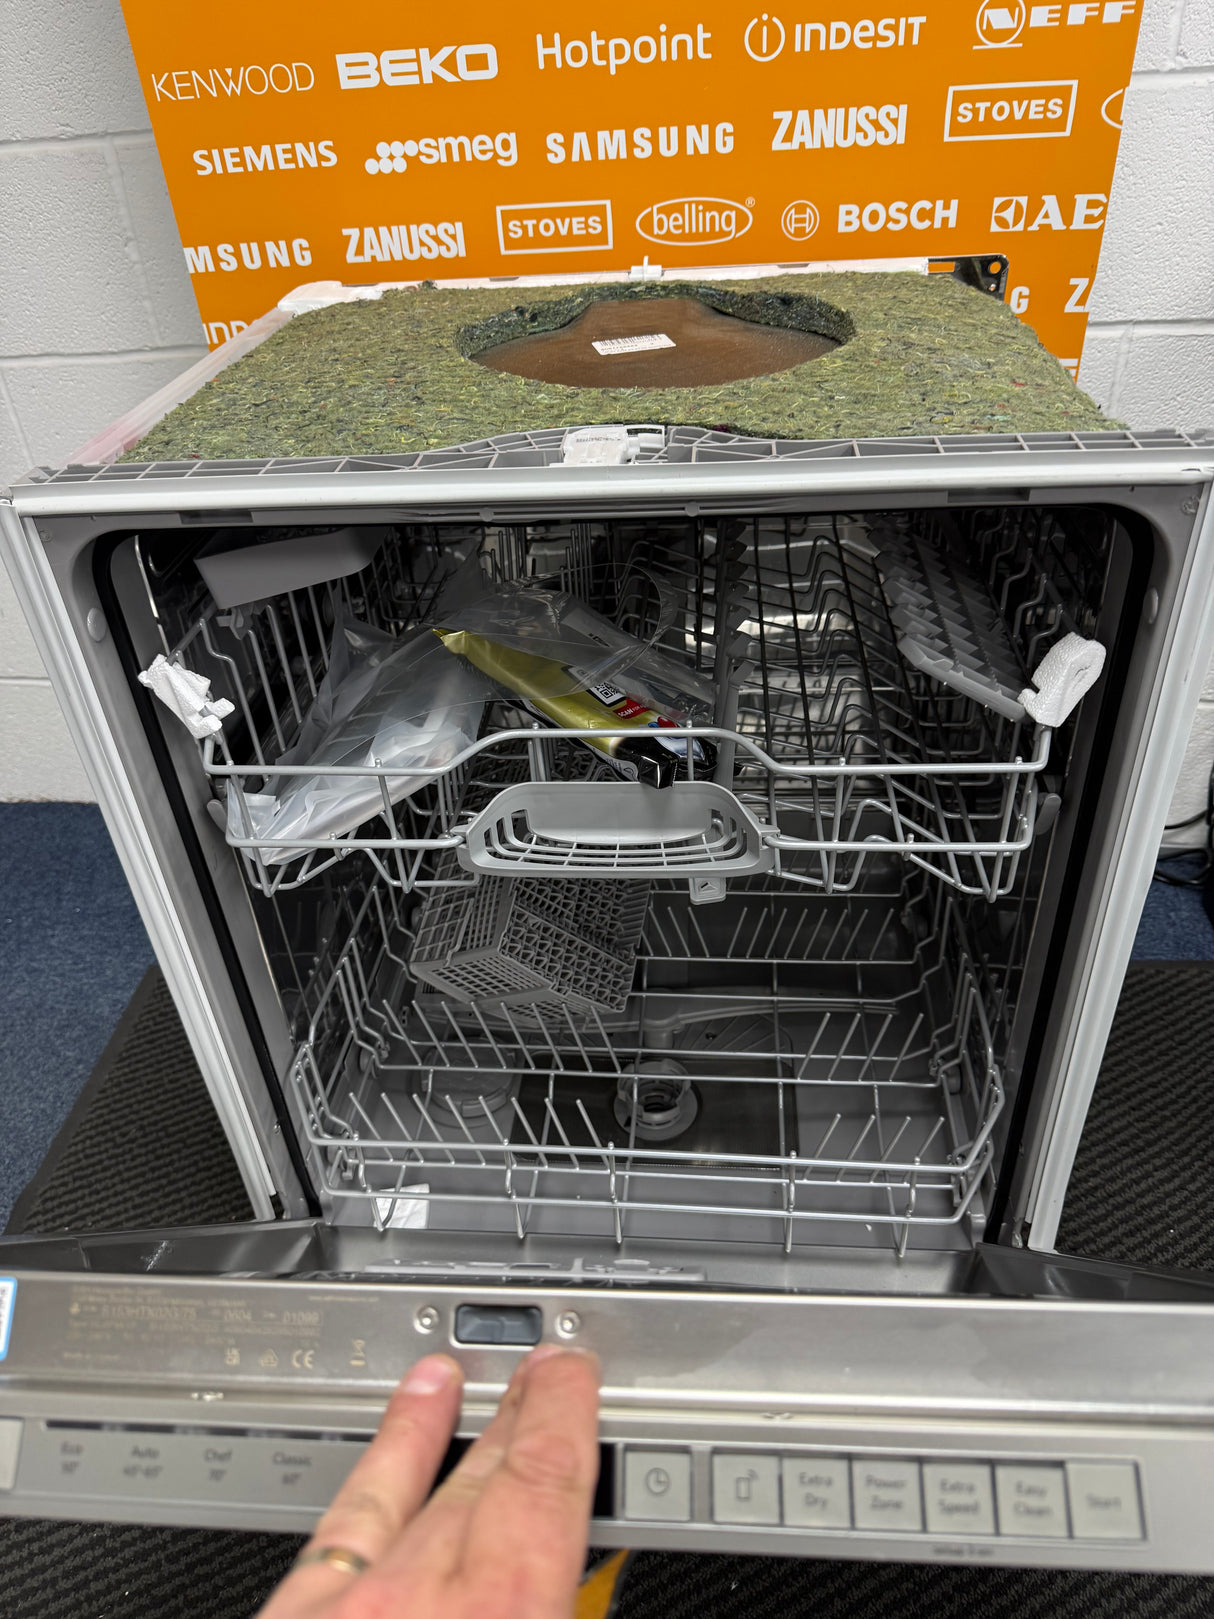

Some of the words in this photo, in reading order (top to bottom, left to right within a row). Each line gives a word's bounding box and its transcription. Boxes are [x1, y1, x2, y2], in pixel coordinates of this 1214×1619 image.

[976, 0, 1136, 49] NEFF
[536, 24, 711, 75] Hotpoint
[152, 63, 314, 101] KENWOOD
[336, 44, 498, 89] BEKO
[957, 98, 1062, 122] STOVES
[546, 122, 733, 163] SAMSUNG
[772, 104, 907, 150] ZANUSSI
[193, 141, 337, 175] SIEMENS
[418, 132, 517, 167] smeg
[508, 216, 602, 238] STOVES
[652, 203, 736, 239] belling
[838, 199, 958, 232] BOSCH
[1027, 193, 1107, 231] AE
[183, 239, 311, 273] MSUNG
[342, 222, 466, 263] ZANUSSI
[1064, 278, 1091, 312] Z
[131, 1445, 160, 1459] Auto
[204, 1449, 232, 1463] Chef
[273, 1452, 312, 1467] Classic
[799, 1472, 833, 1488] Extra
[865, 1474, 905, 1490] Power
[940, 1478, 975, 1495] Extra
[1015, 1481, 1047, 1498] Easy
[804, 1492, 828, 1510] Dry
[938, 1498, 980, 1517] Speed
[1014, 1502, 1053, 1518] Clean
